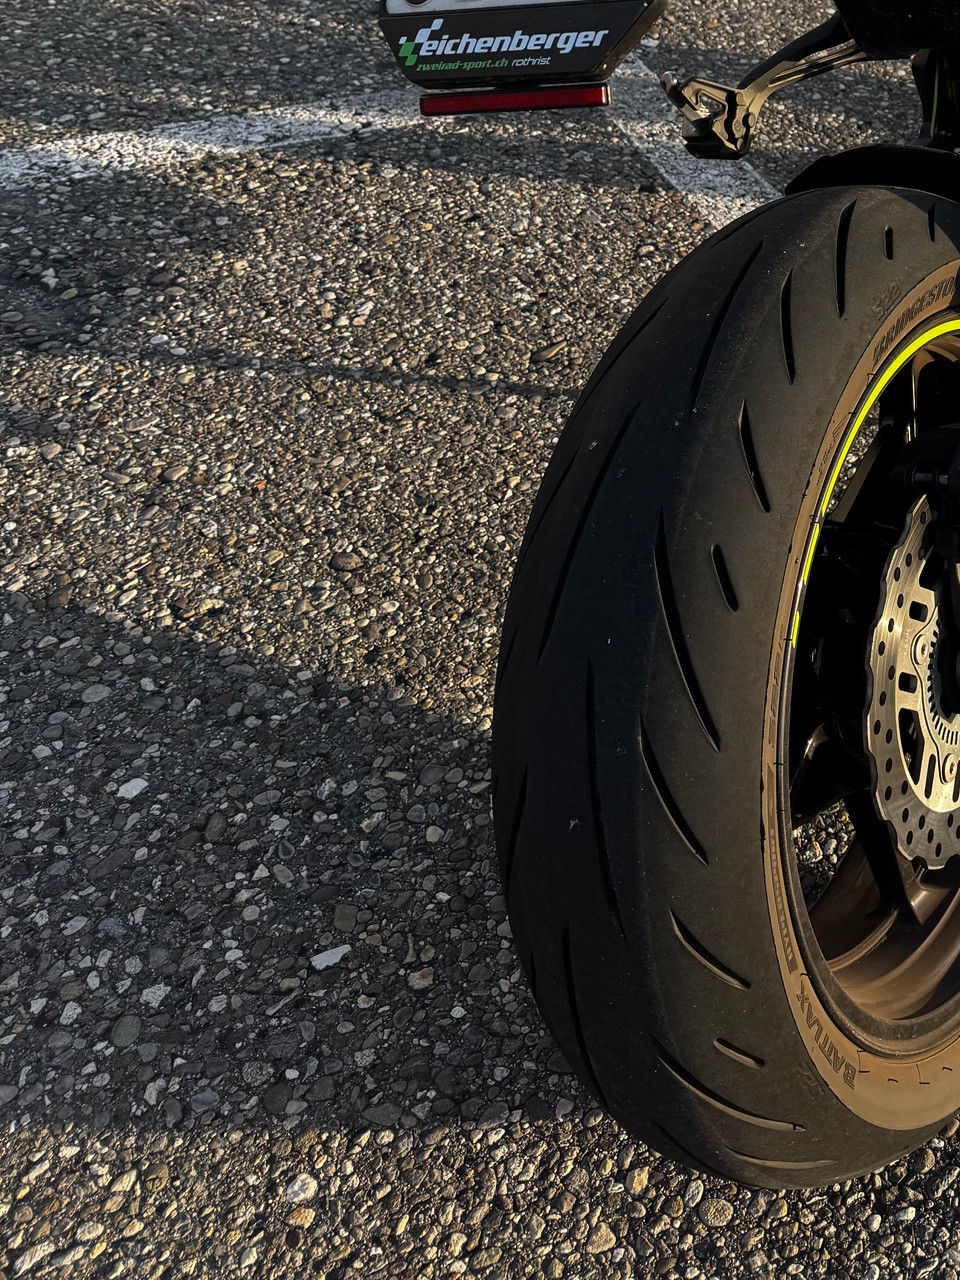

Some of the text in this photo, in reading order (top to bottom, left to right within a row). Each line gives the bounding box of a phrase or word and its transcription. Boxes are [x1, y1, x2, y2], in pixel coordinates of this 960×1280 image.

[419, 29, 610, 56] eichenberger
[416, 56, 552, 72] zweirad-sport.ch rothrist
[795, 979, 857, 1090] BATTLAX
